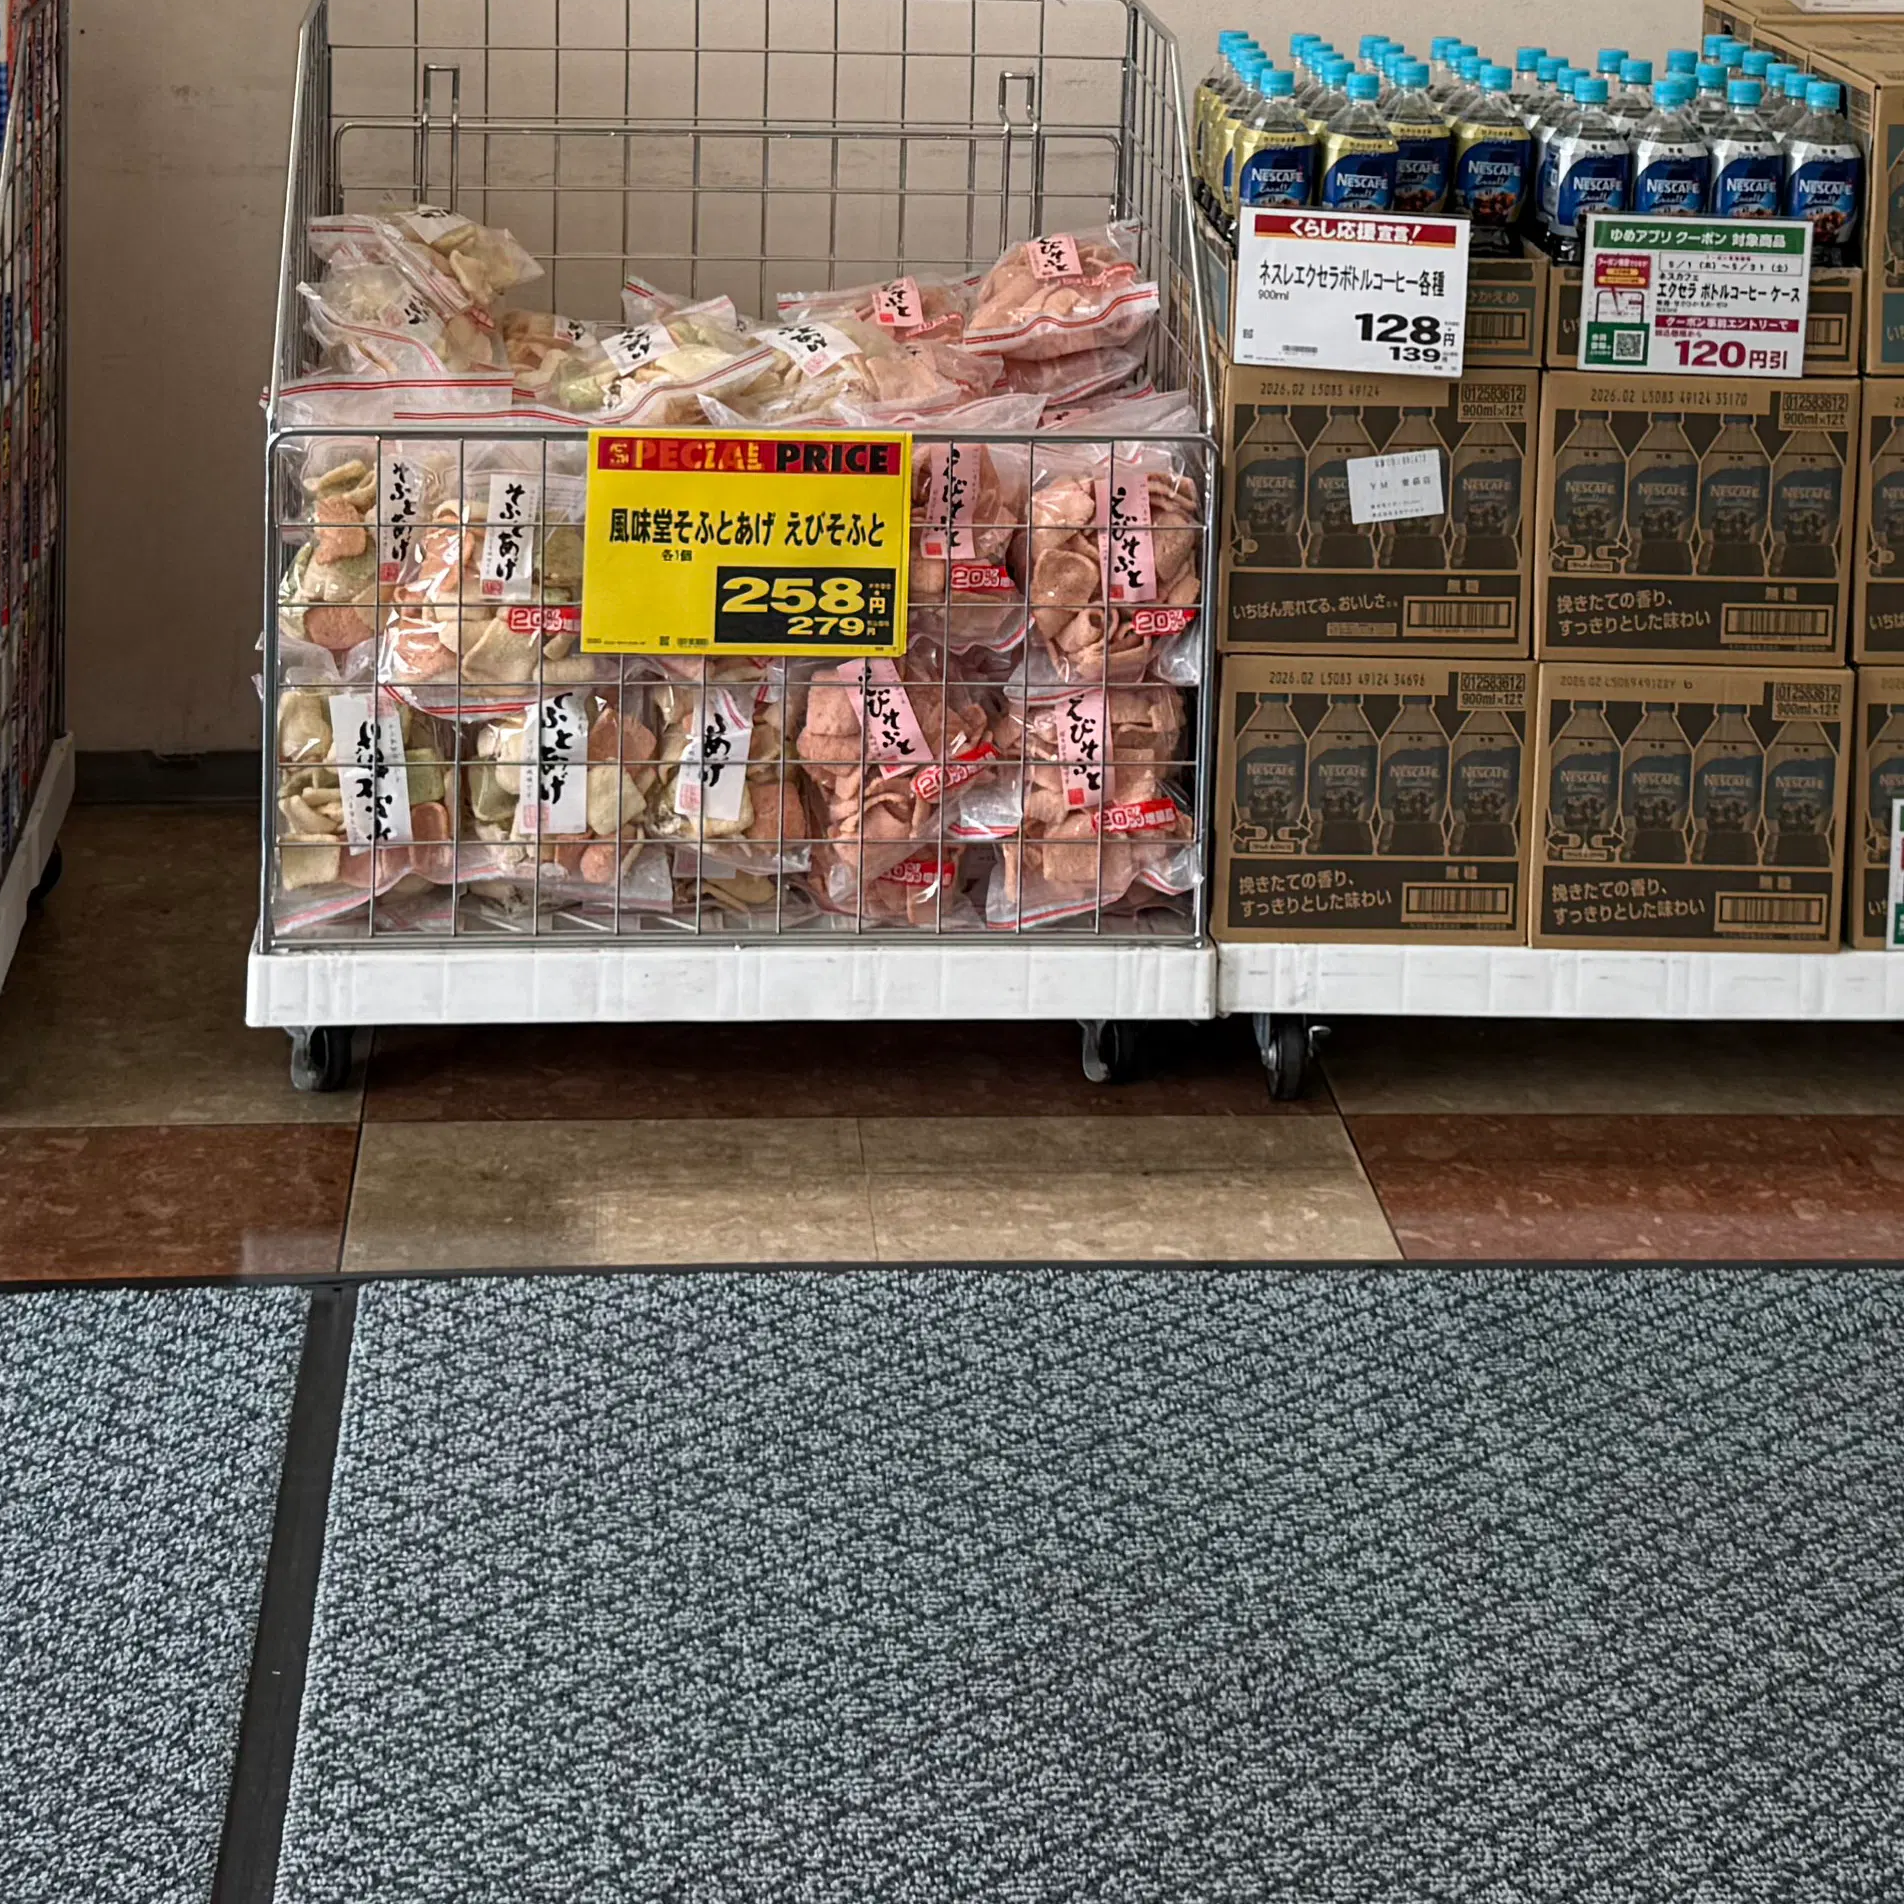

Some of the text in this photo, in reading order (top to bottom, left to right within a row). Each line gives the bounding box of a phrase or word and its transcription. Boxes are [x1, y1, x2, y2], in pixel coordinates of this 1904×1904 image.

[1258, 260, 1445, 298] ネスレエクセラボトルコーヒー各種
[1656, 282, 1800, 303] エクセラ ボトルコーヒー ケース
[1388, 346, 1441, 363] 139
[608, 439, 889, 473] SPECIAL PRICE
[609, 507, 885, 547] 風味堂そふとあげ えびそふと
